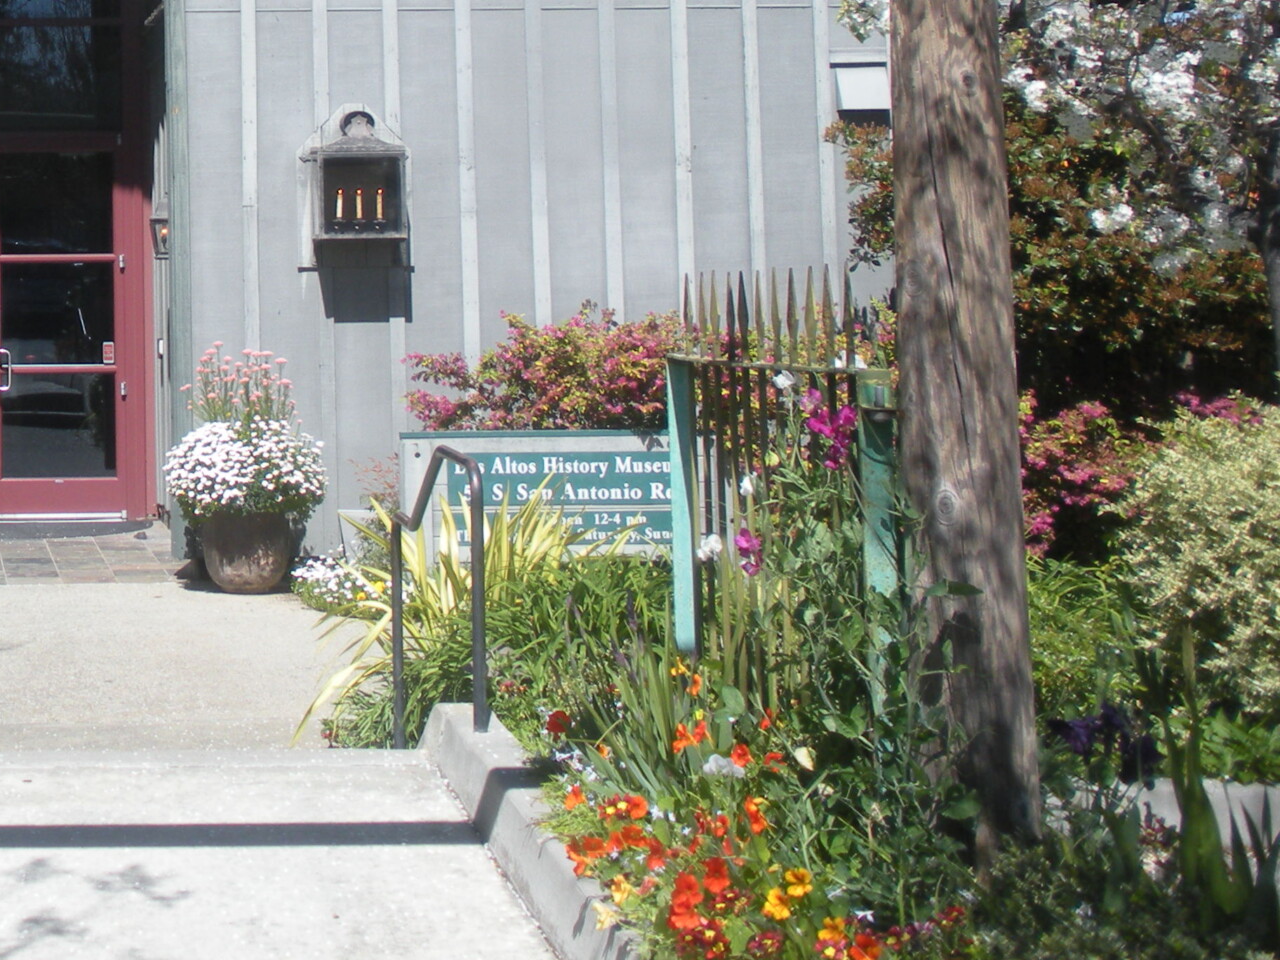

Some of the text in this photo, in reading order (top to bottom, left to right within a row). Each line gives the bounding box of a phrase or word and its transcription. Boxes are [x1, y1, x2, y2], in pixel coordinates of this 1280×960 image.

[454, 455, 671, 478] Ls Altos History Museu
[560, 482, 643, 500] Antonio
[594, 513, 621, 525] 12-4
